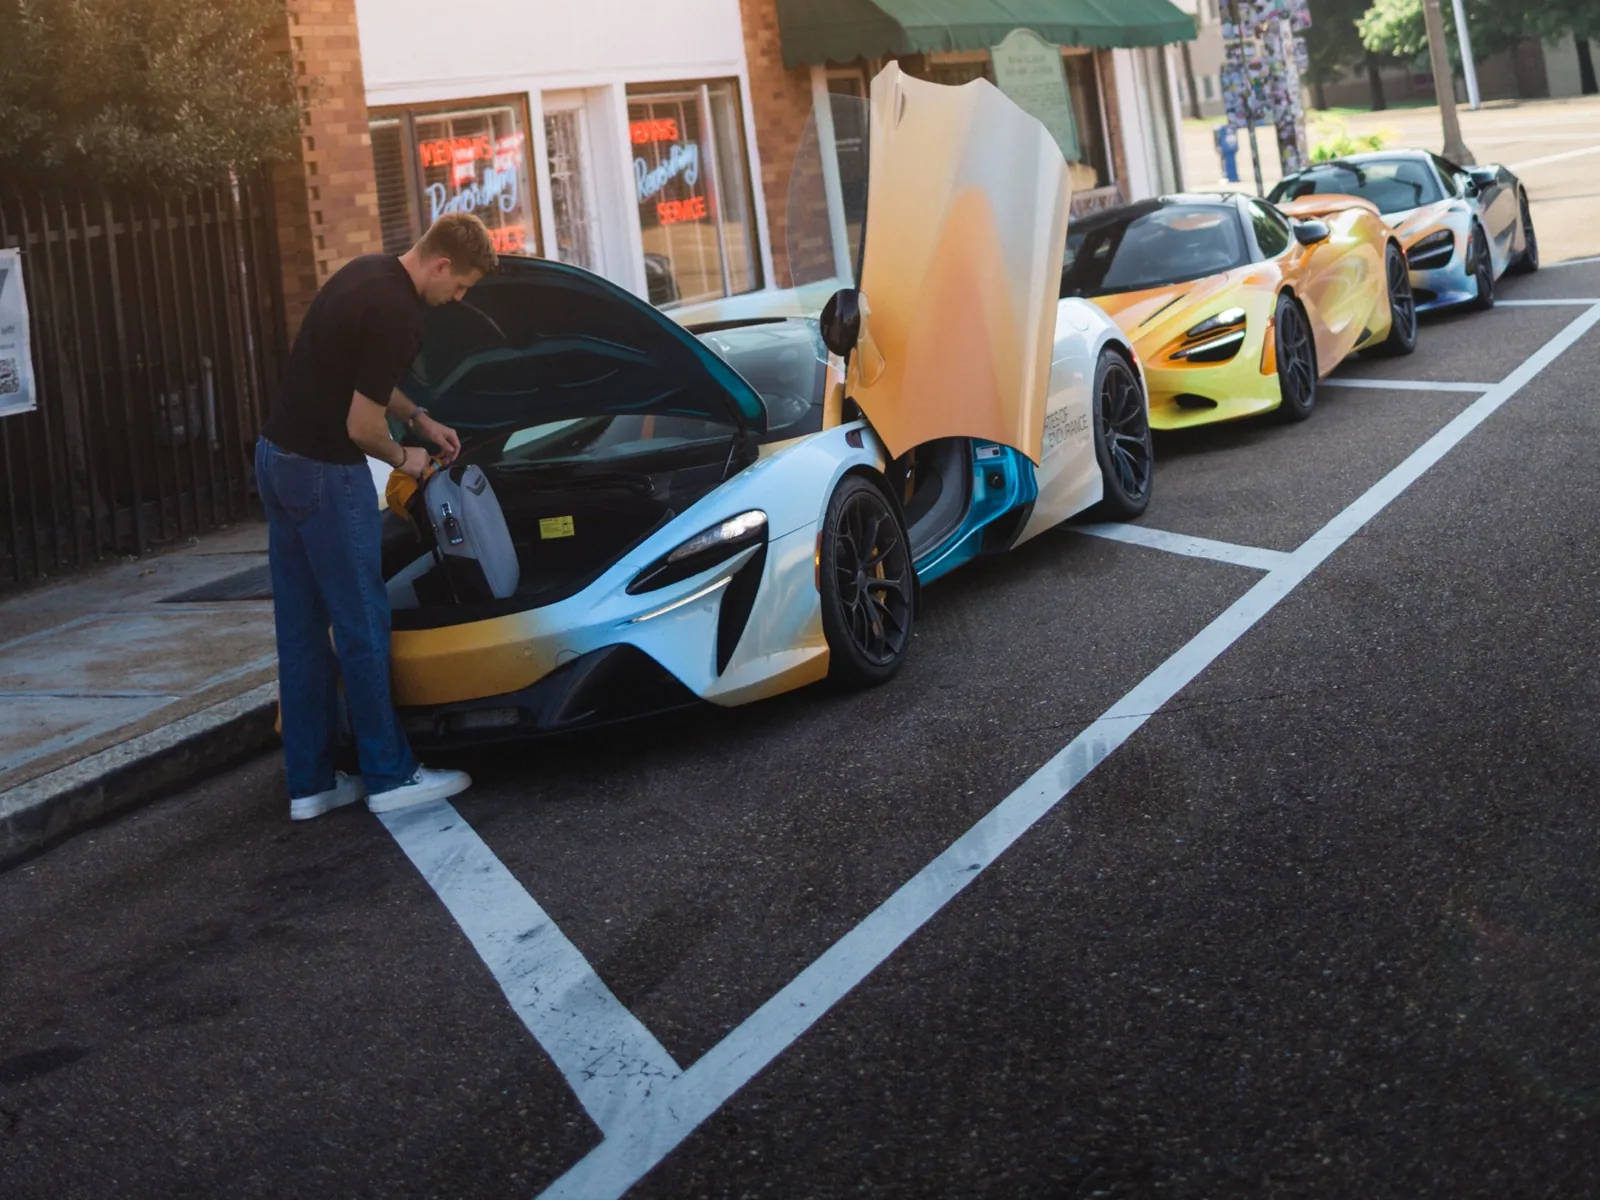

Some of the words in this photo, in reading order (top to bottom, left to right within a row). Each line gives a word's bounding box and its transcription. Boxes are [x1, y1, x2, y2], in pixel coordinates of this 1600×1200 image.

[656, 196, 707, 225] SERVICE
[487, 224, 527, 256] VICE
[1049, 414, 1088, 448] ENDURANCE
